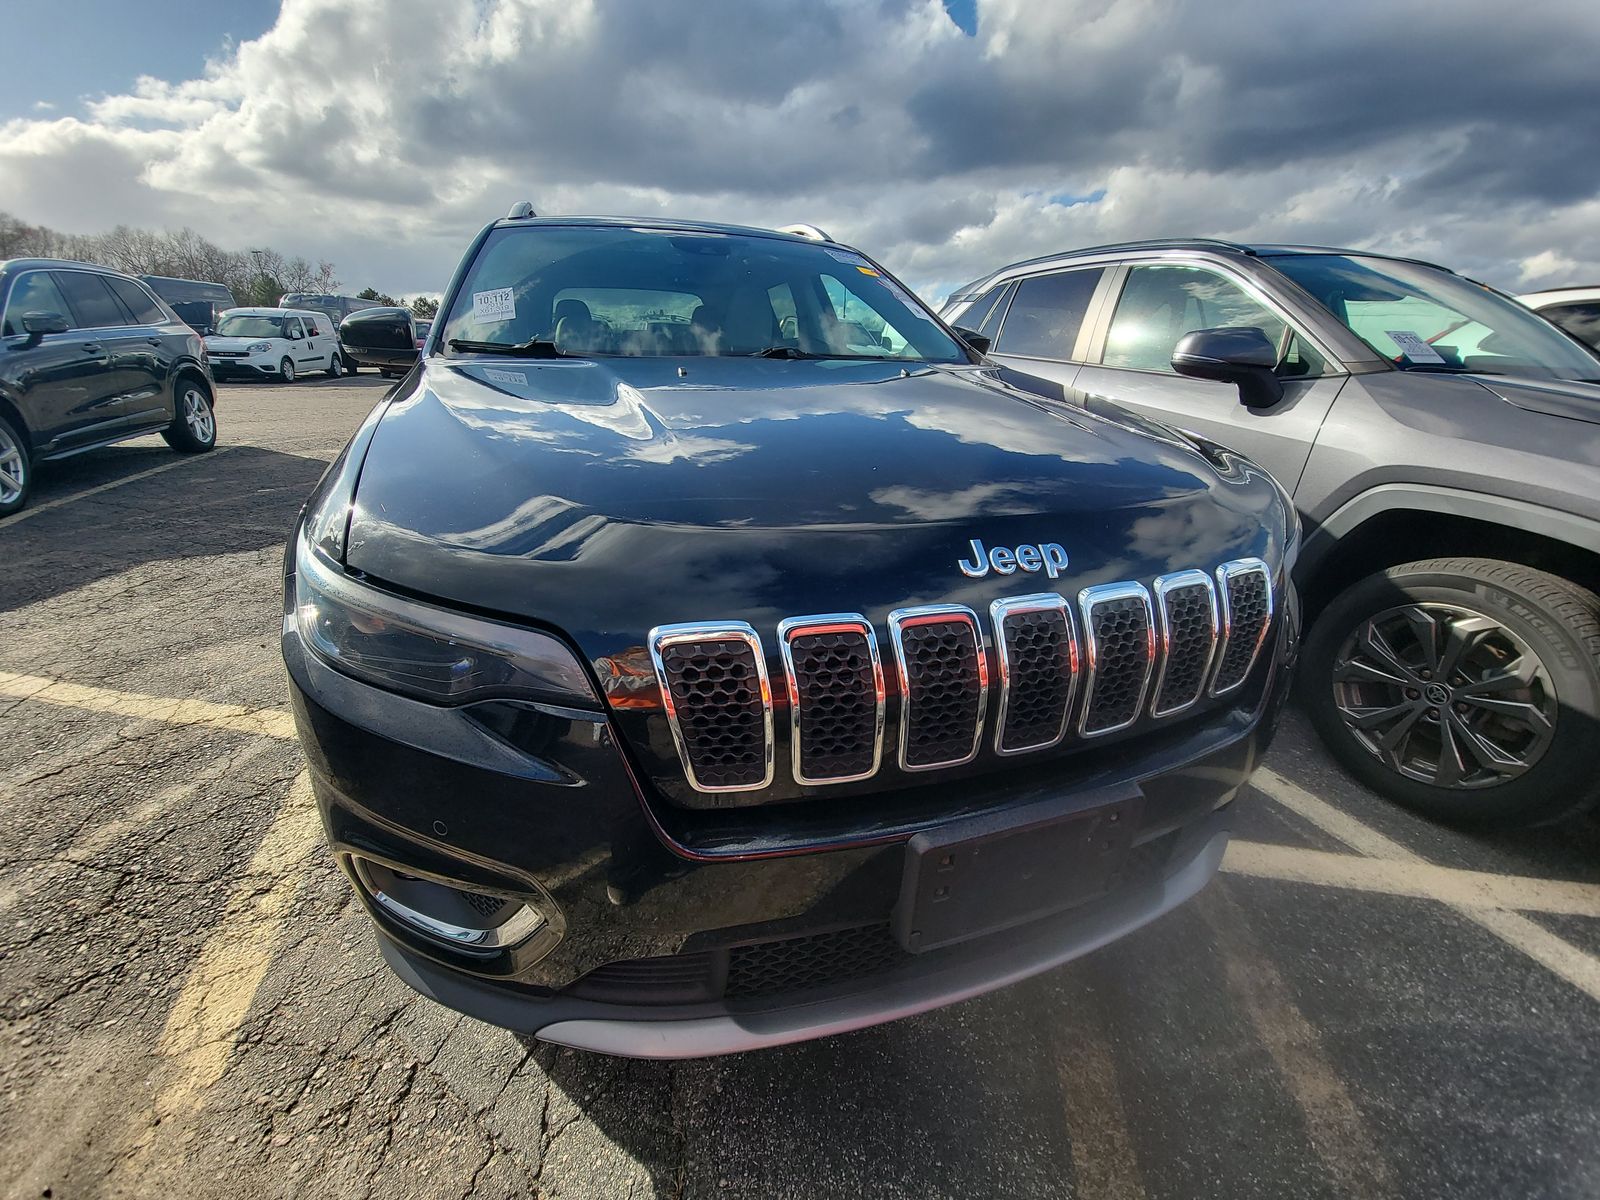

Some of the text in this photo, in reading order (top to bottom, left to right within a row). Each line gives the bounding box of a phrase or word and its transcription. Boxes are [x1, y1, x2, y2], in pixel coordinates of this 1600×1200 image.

[478, 293, 510, 305] 10:112
[958, 539, 1069, 578] Jeep
[1509, 603, 1579, 670] MICHELIN
